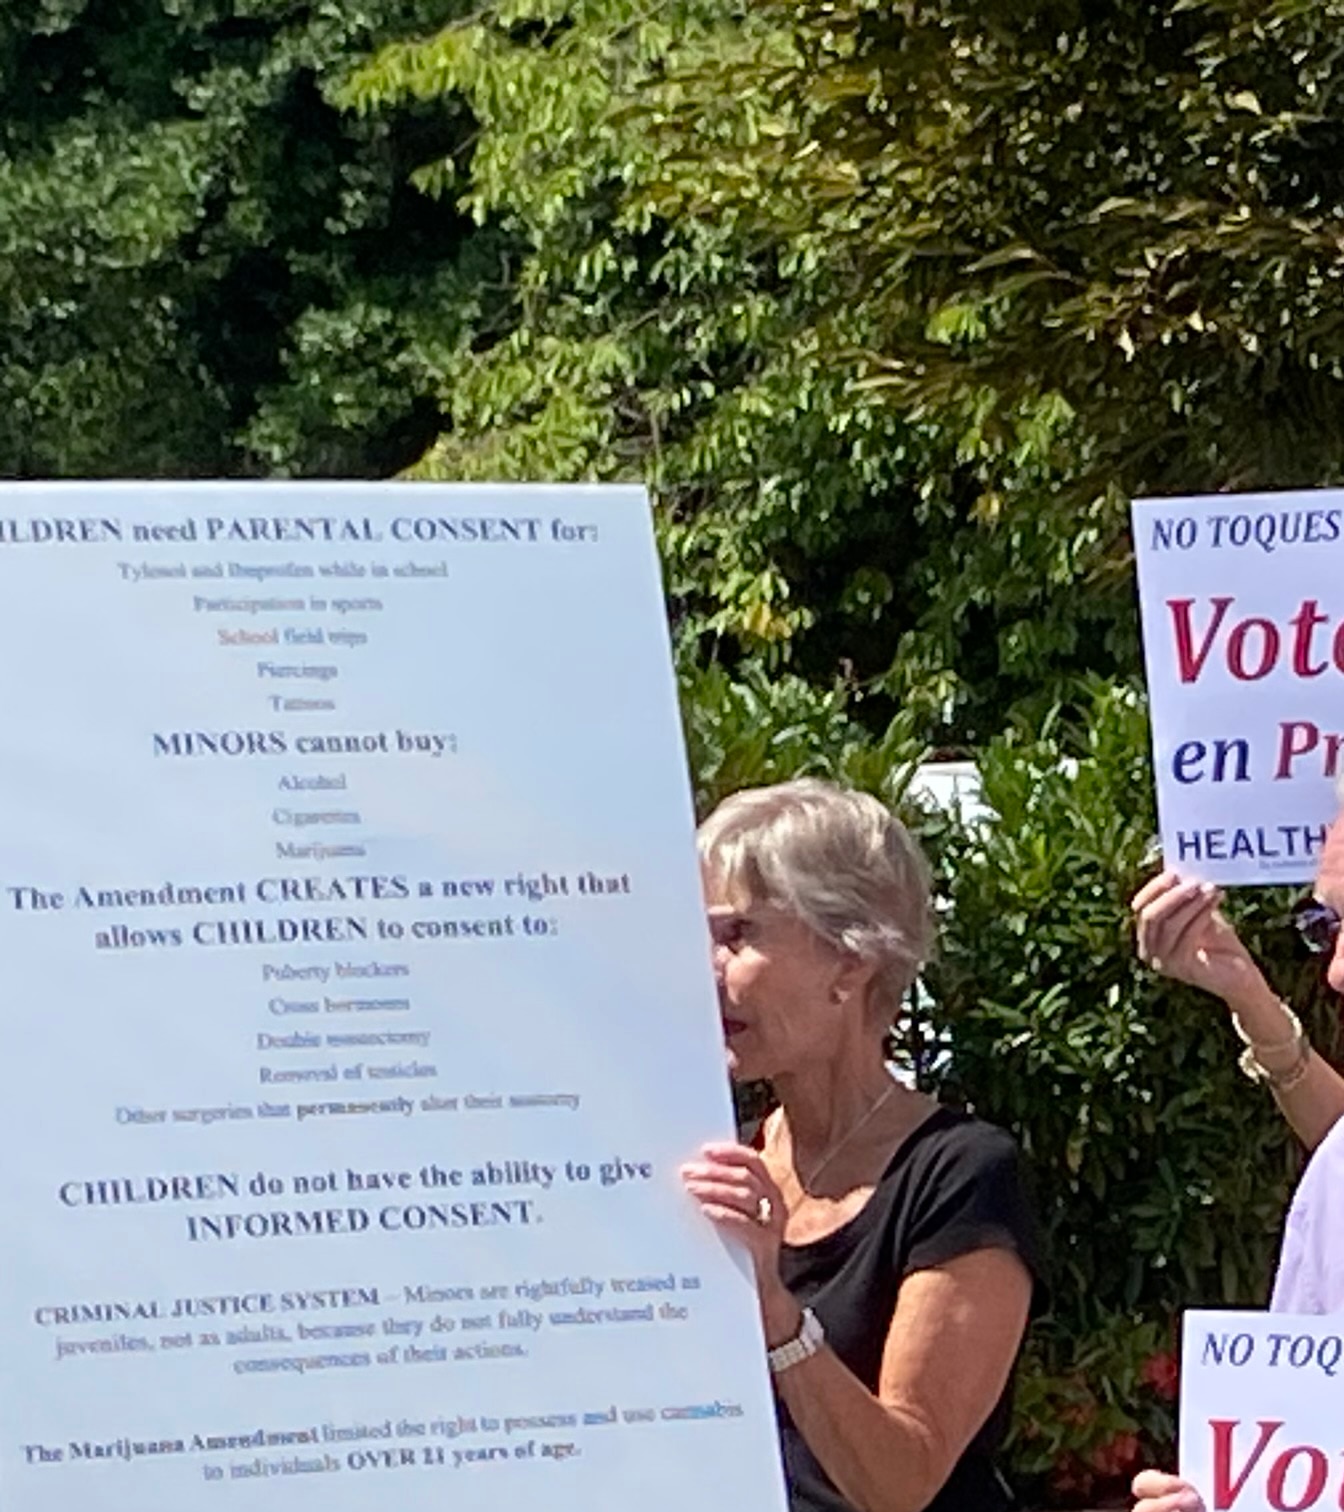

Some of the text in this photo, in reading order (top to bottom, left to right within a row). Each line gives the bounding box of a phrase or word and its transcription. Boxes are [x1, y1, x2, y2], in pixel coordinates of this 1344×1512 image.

[132, 517, 599, 543] need PARENTAL CONSENT for:
[1151, 517, 1198, 551] NO
[1207, 509, 1343, 553] TOQUES
[216, 627, 279, 646] School
[153, 729, 459, 758] MINORS cannot buy:
[1172, 737, 1251, 785] en
[7, 871, 632, 911] The Amendment CREATES a new right that
[95, 913, 559, 950] allows CHILDREN to consent to:
[59, 1156, 654, 1207] CHILDREN do not have the ability to give
[186, 1199, 545, 1242] INFORMED CONSENT.
[34, 1301, 168, 1328] CRIMINAL
[170, 1292, 277, 1319] JUSTICE
[280, 1287, 382, 1312] SYSTEM
[1201, 1331, 1255, 1367] NO
[24, 1443, 64, 1465] The
[68, 1435, 186, 1461] Marijuana
[190, 1426, 320, 1452] Amendment
[347, 1446, 415, 1470] OVER
[452, 1443, 510, 1468] years
[514, 1440, 536, 1459] of
